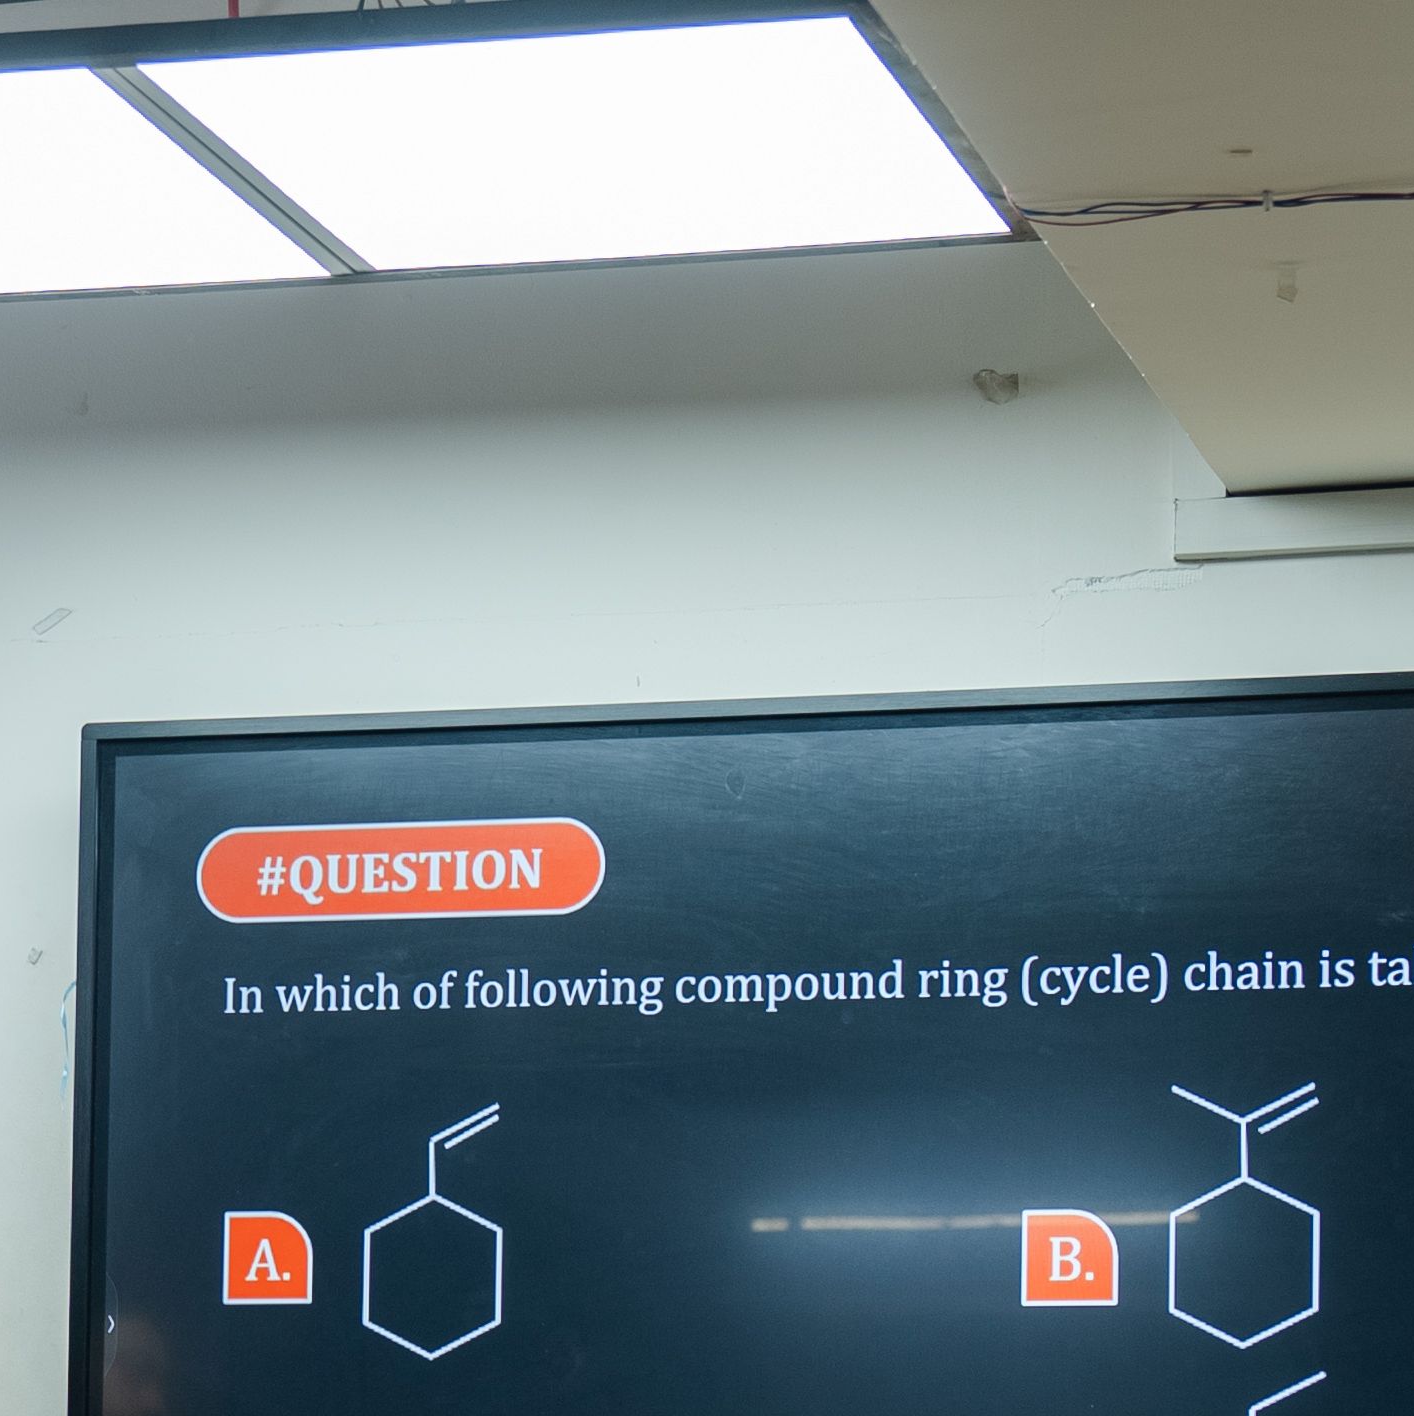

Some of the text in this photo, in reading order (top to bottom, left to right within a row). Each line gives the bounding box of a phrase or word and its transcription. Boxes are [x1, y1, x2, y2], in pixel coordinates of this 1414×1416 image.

[257, 848, 544, 905] #QUESTION
[223, 977, 264, 1014] In
[275, 974, 399, 1013] which
[413, 971, 458, 1010] of
[464, 968, 663, 1016] following
[675, 959, 904, 1013] compound
[918, 957, 1009, 1008] ring
[1021, 953, 1169, 1007] (cycle)
[1185, 951, 1306, 992] chain
[1319, 949, 1356, 988] is
[245, 1239, 291, 1282] A.
[1048, 1236, 1095, 1282] B.
